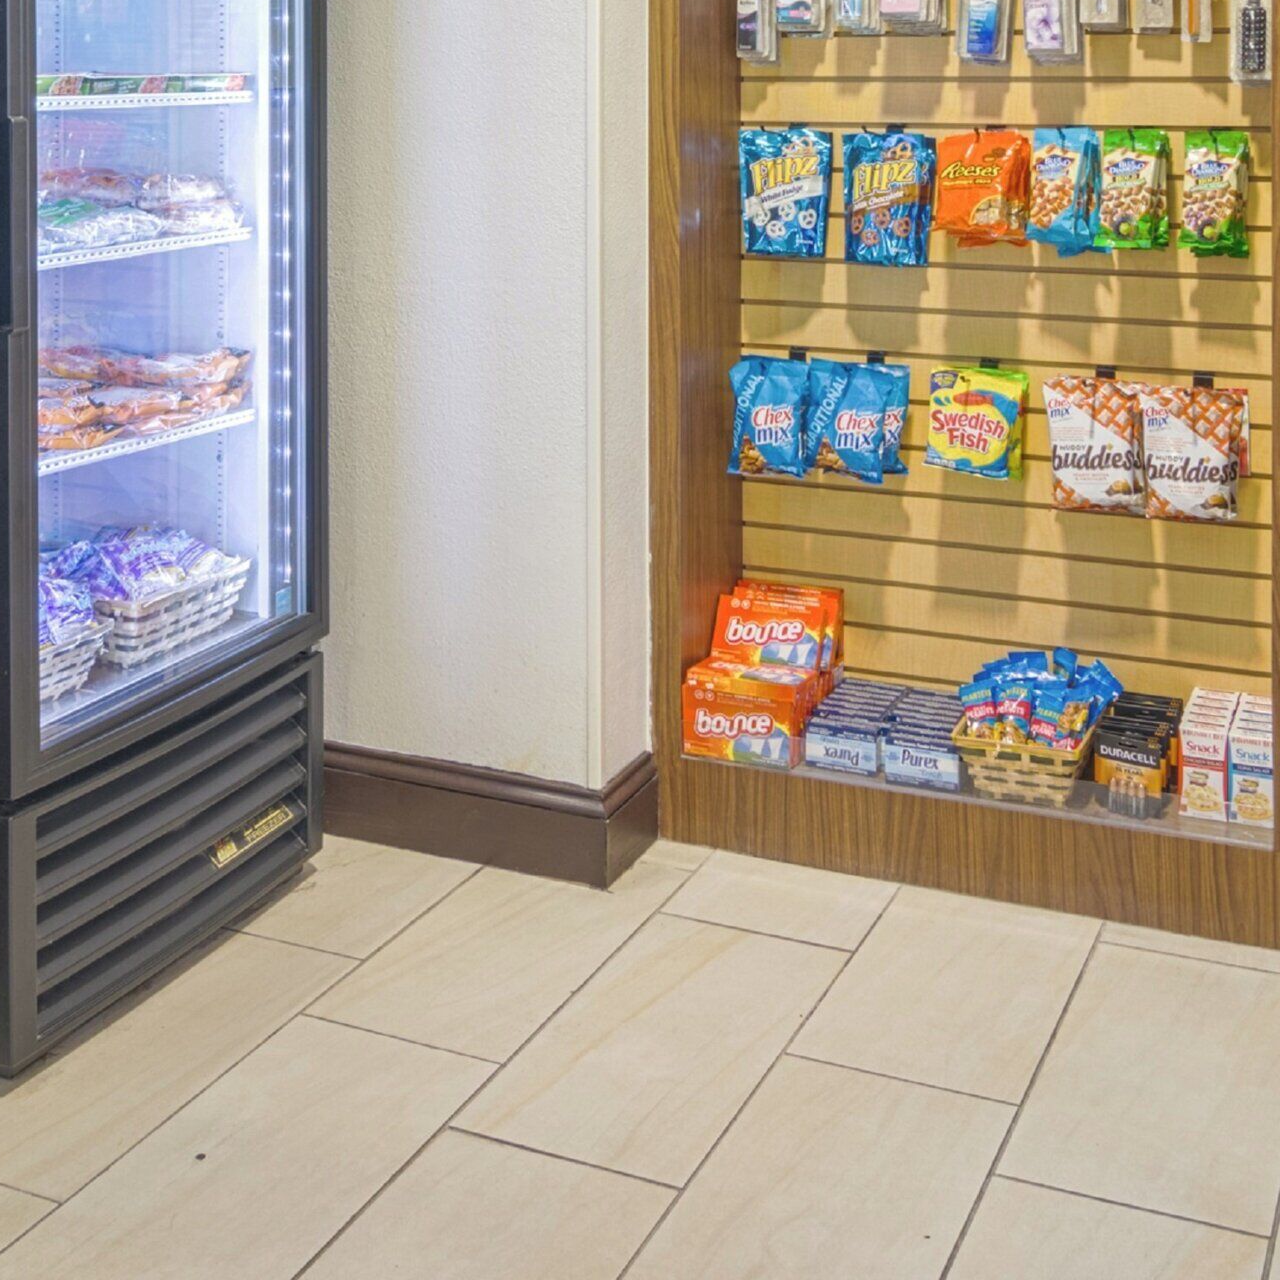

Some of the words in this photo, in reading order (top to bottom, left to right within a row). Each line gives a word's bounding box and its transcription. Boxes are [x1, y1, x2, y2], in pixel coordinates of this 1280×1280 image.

[750, 153, 819, 199] Flipz
[852, 158, 917, 202] Flipz
[941, 161, 1001, 179] Reese's
[752, 405, 796, 428] Chex
[836, 409, 880, 433] Chex
[1050, 408, 1071, 419] mix
[1144, 407, 1171, 418] Chex
[1146, 416, 1170, 428] mix
[755, 425, 793, 445] mix
[930, 408, 1007, 440] Swedish
[837, 429, 876, 451] mix
[947, 428, 990, 454] Fish
[726, 616, 806, 646] bounce
[695, 708, 775, 738] bounce
[1099, 744, 1157, 766] DURACELL
[1186, 740, 1221, 755] Snack
[1235, 747, 1271, 762] Snack
[901, 748, 940, 771] Purex
